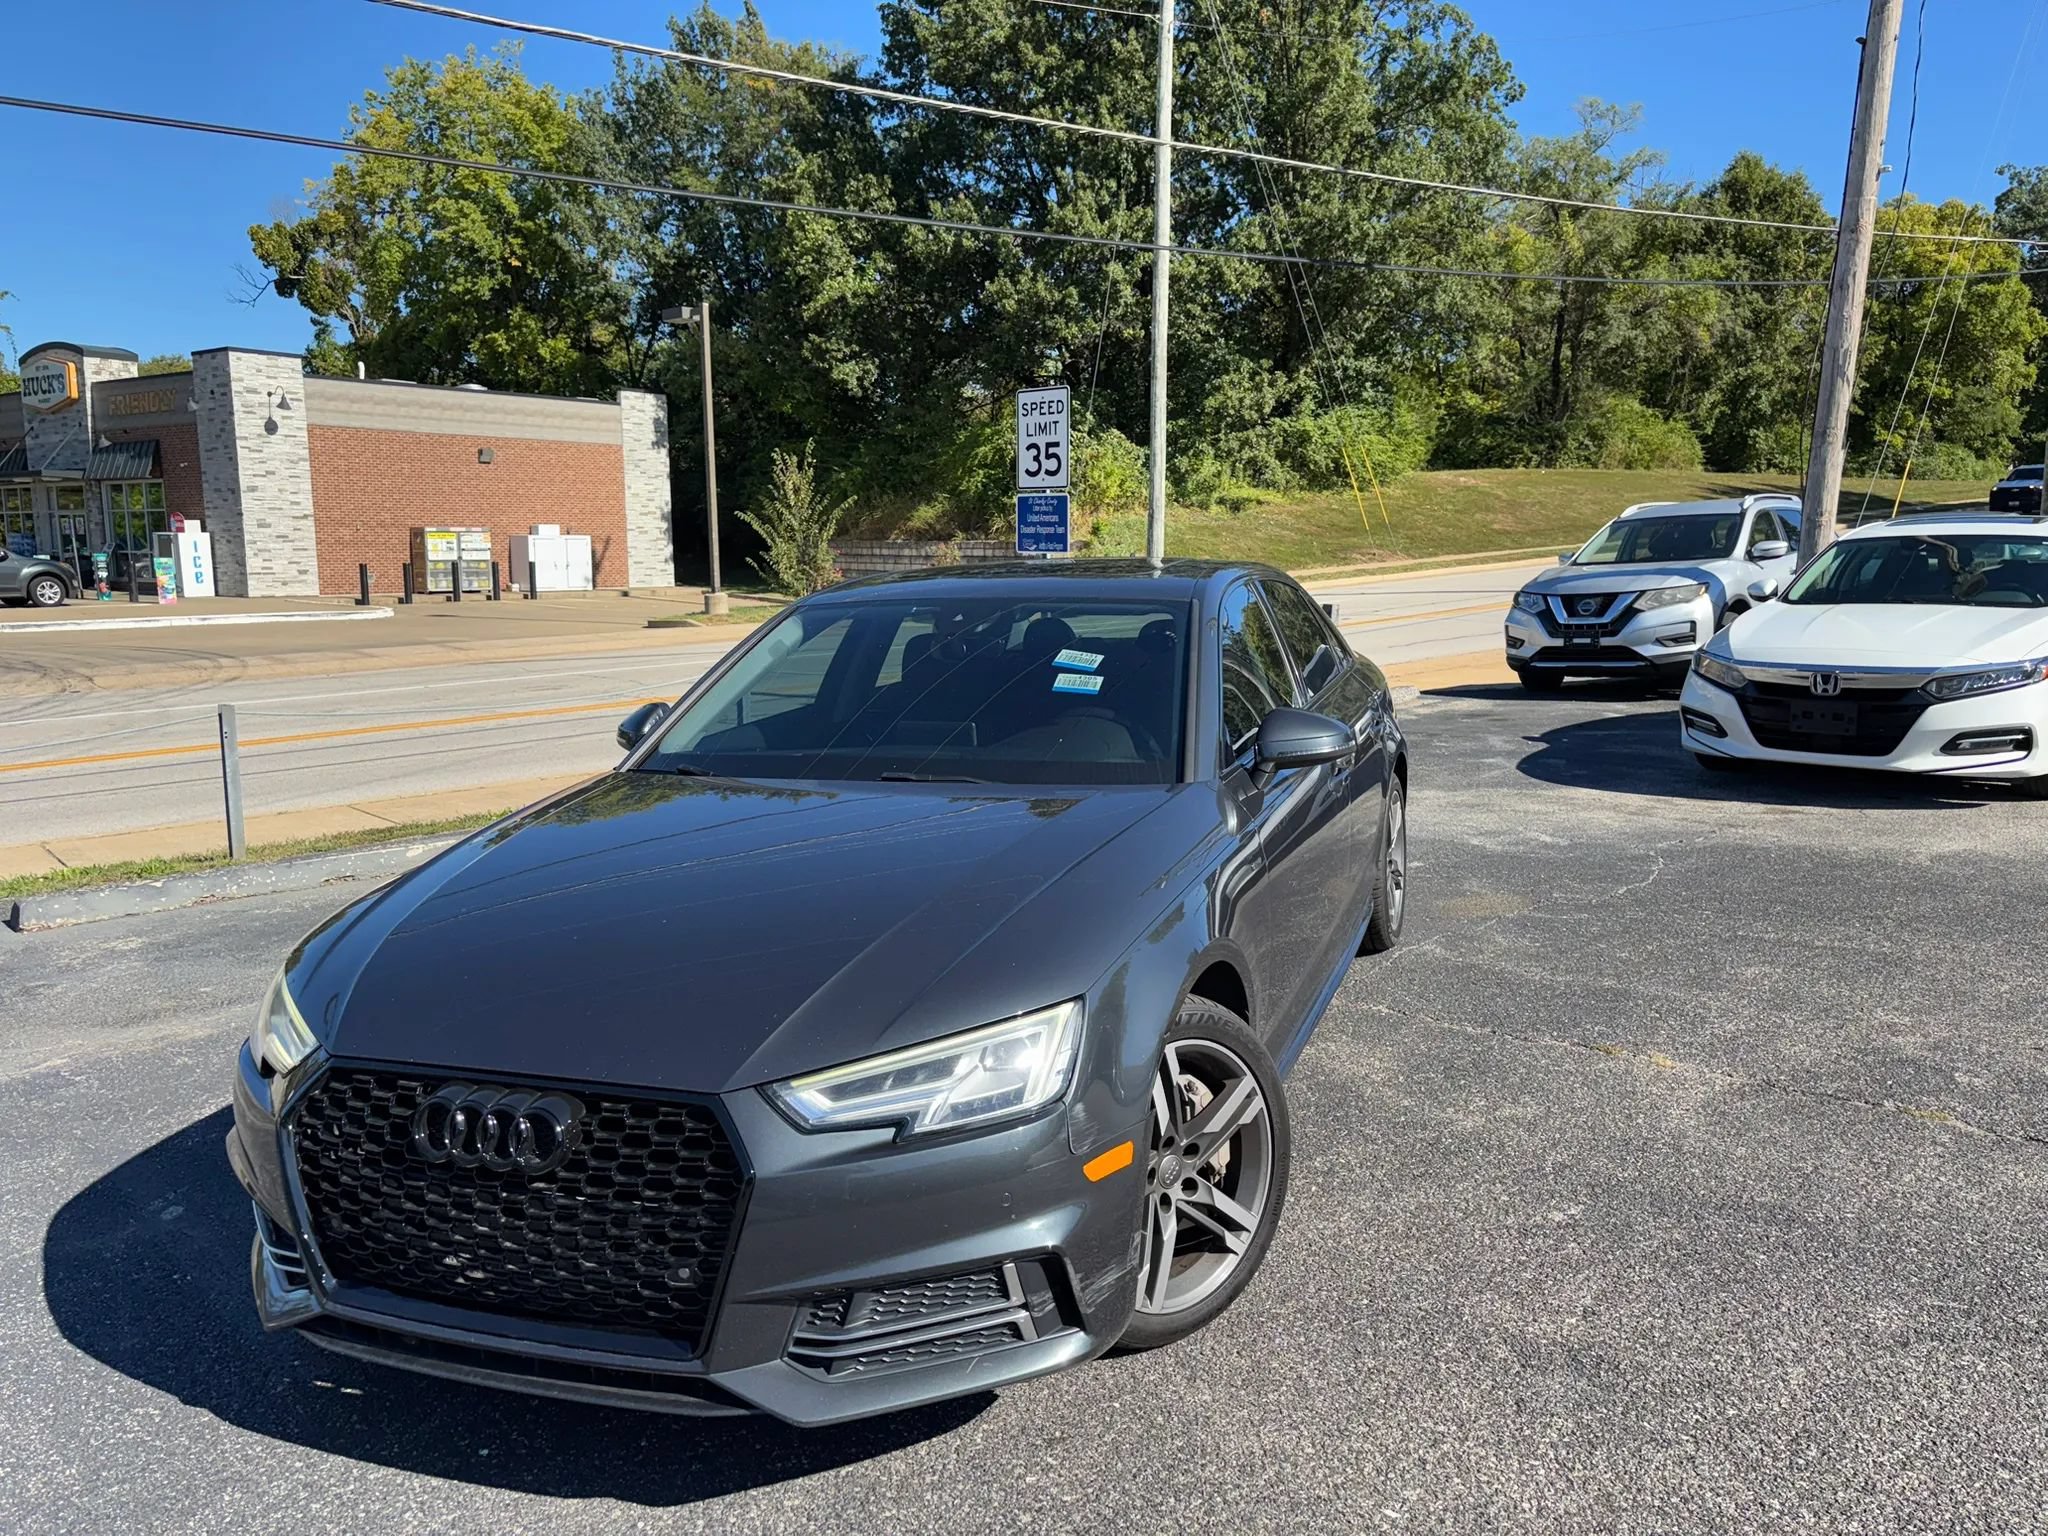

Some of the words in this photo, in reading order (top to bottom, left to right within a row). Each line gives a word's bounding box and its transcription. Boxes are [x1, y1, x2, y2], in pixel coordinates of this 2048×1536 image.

[22, 372, 66, 398] HUCK'S
[108, 388, 177, 416] FRIENDLY
[1021, 399, 1065, 418] SPEED
[1026, 420, 1060, 437] LIMIT
[1024, 441, 1062, 478] 35
[1027, 513, 1039, 522] United
[1055, 524, 1065, 534] Team
